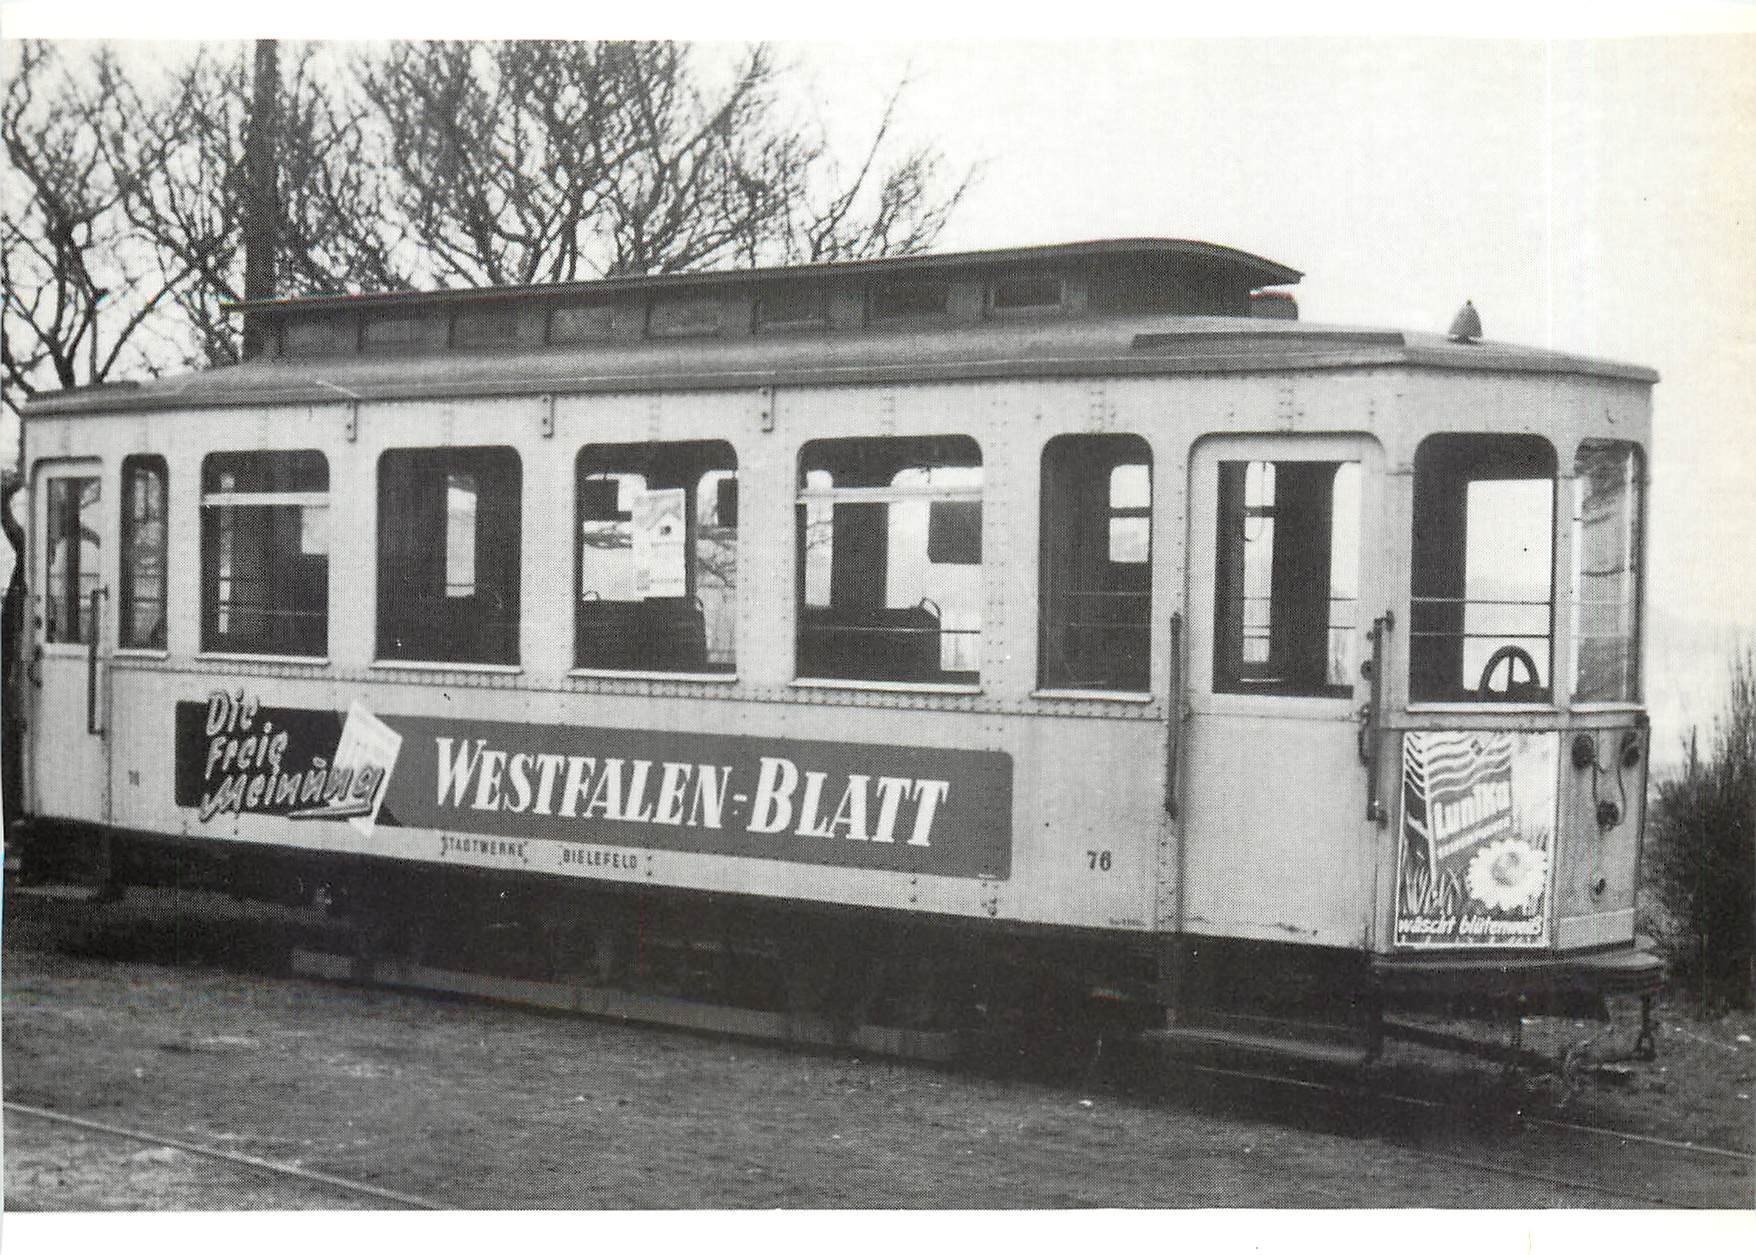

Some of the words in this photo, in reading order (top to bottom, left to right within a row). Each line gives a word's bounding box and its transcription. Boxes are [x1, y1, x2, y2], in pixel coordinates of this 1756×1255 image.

[206, 688, 259, 737] Die
[435, 736, 949, 848] WESTFALEN-BLATT
[442, 836, 525, 859] STADTWERKE
[562, 848, 638, 870] BIELEFELD
[1086, 850, 1112, 872] 76
